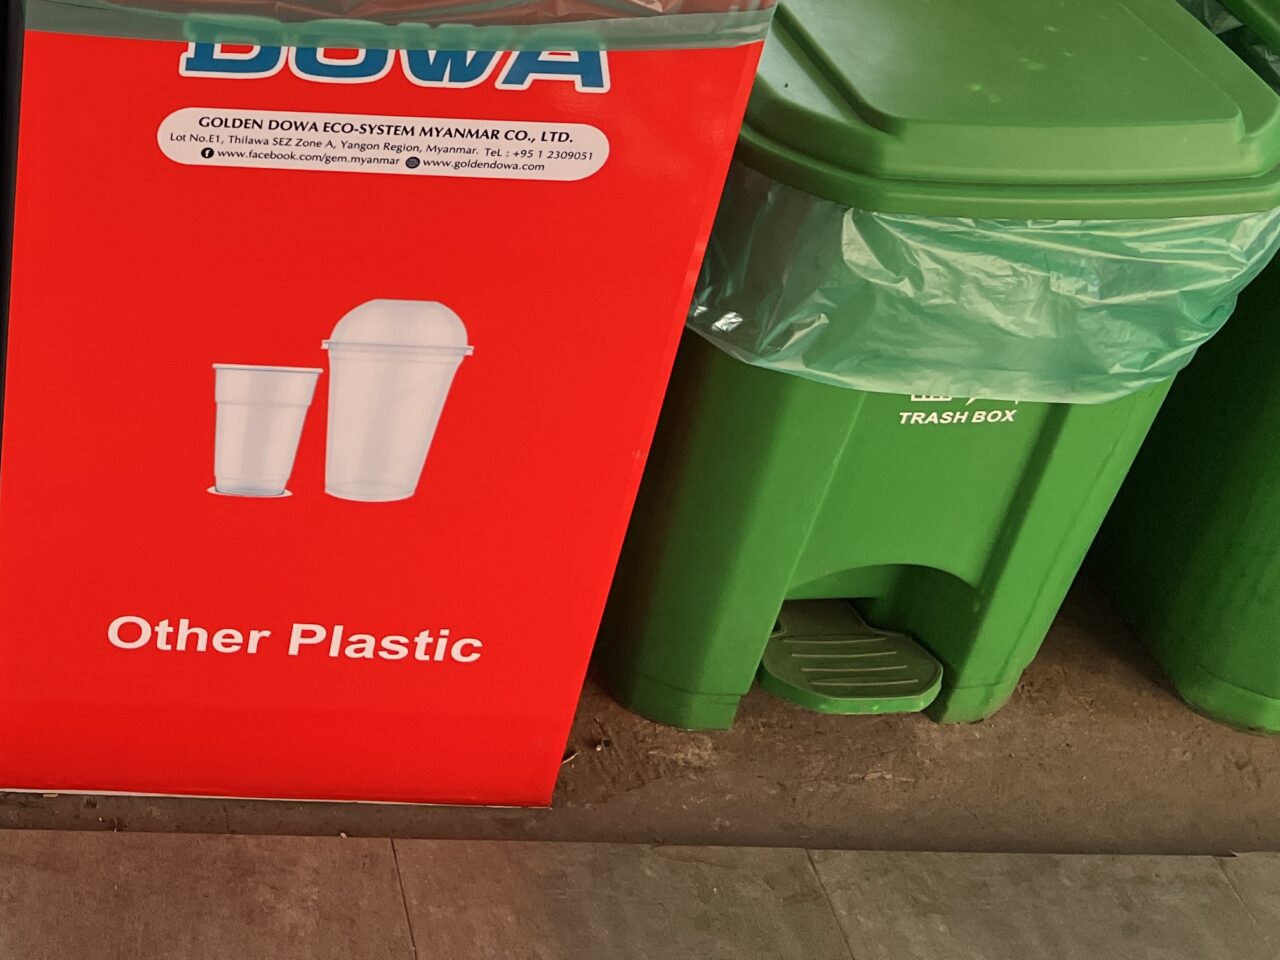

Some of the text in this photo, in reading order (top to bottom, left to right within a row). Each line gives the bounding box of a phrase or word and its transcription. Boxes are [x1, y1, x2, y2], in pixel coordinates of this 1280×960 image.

[178, 12, 611, 94] DOWA
[198, 116, 573, 143] GOLDEN DOWA ECO-SYSTEM MYANMAR CO., LTD.
[170, 132, 186, 142] Lot
[229, 135, 269, 146] Thilawa
[272, 137, 292, 147] SEZ
[295, 138, 322, 148] Zone
[325, 140, 336, 149] A,
[341, 141, 380, 152] Yangon
[383, 142, 422, 154] Region,
[426, 144, 479, 157] Myanmar.
[513, 150, 534, 159] +95
[547, 151, 593, 161] 2309051
[217, 149, 400, 166] www.facebook.com/gem.myanmar
[423, 158, 545, 172] www.goldendowa.com
[899, 409, 1017, 425] TRASH BOX
[107, 615, 484, 664] Other Plastic
